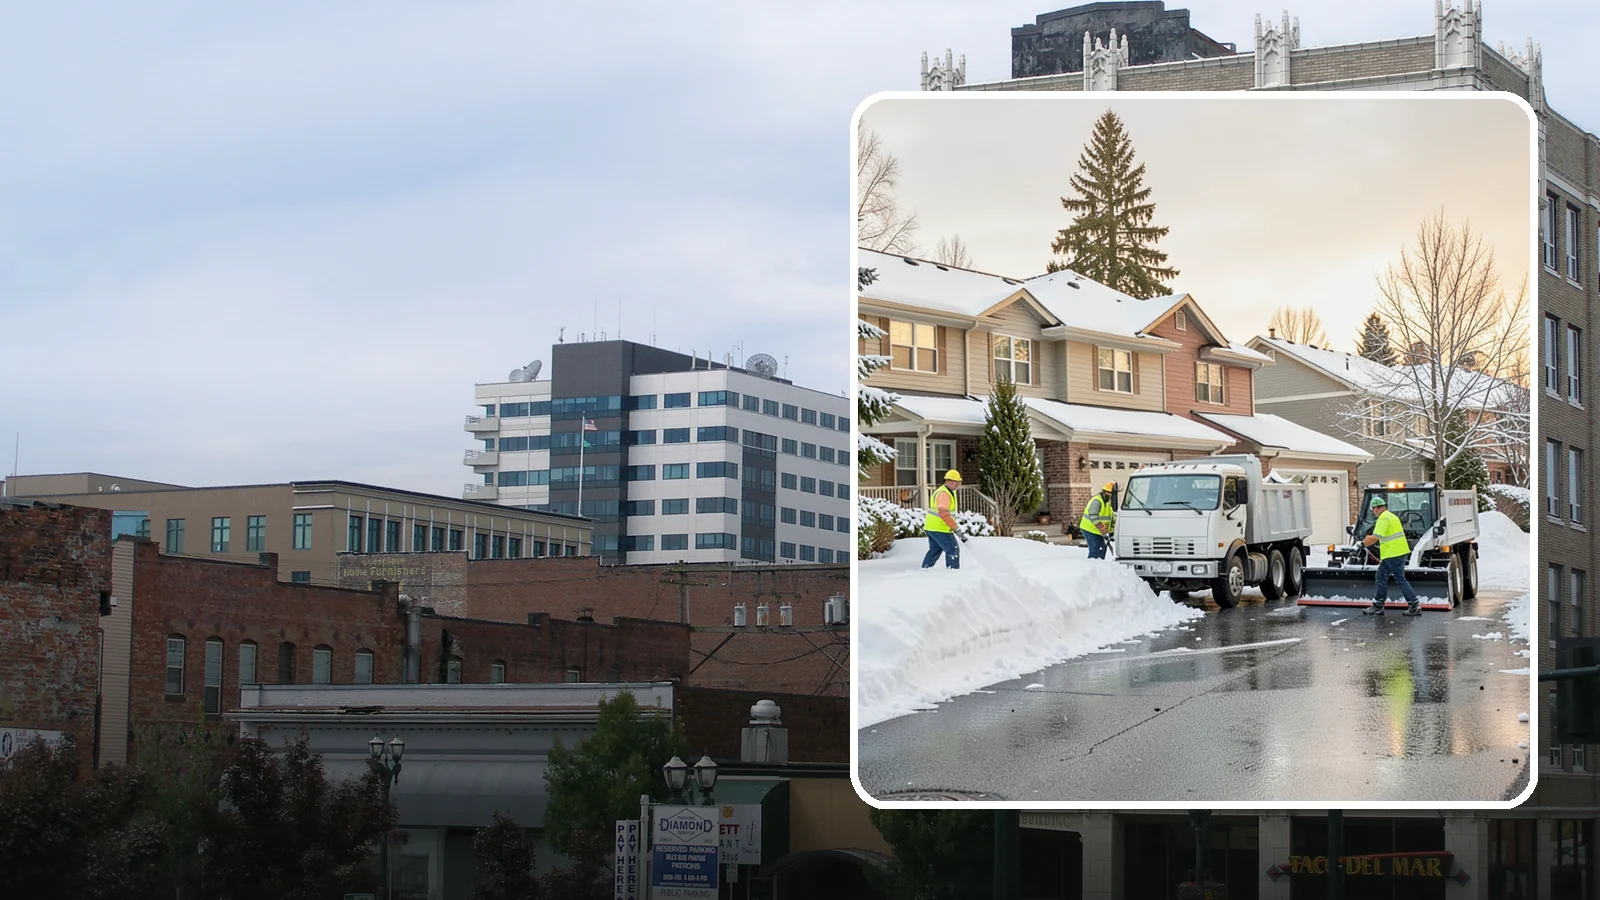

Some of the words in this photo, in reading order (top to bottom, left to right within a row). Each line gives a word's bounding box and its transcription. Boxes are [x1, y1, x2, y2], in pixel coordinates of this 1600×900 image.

[371, 565, 428, 576] Furnishers
[660, 818, 713, 833] DIAMOND
[1022, 815, 1070, 828] BUILDING
[720, 824, 740, 835] ETT
[617, 824, 625, 853] PAY
[628, 824, 637, 853] PAY
[655, 845, 688, 853] RESERVED
[689, 846, 716, 854] PARKING
[721, 851, 739, 862] Soup
[671, 861, 701, 870] PATRONS
[1346, 856, 1385, 876] DEL
[1391, 857, 1442, 877] MAR
[616, 856, 625, 893] HERE
[627, 856, 636, 893] HERE
[660, 888, 682, 897] PUBLIC
[683, 889, 710, 898] PARKING
